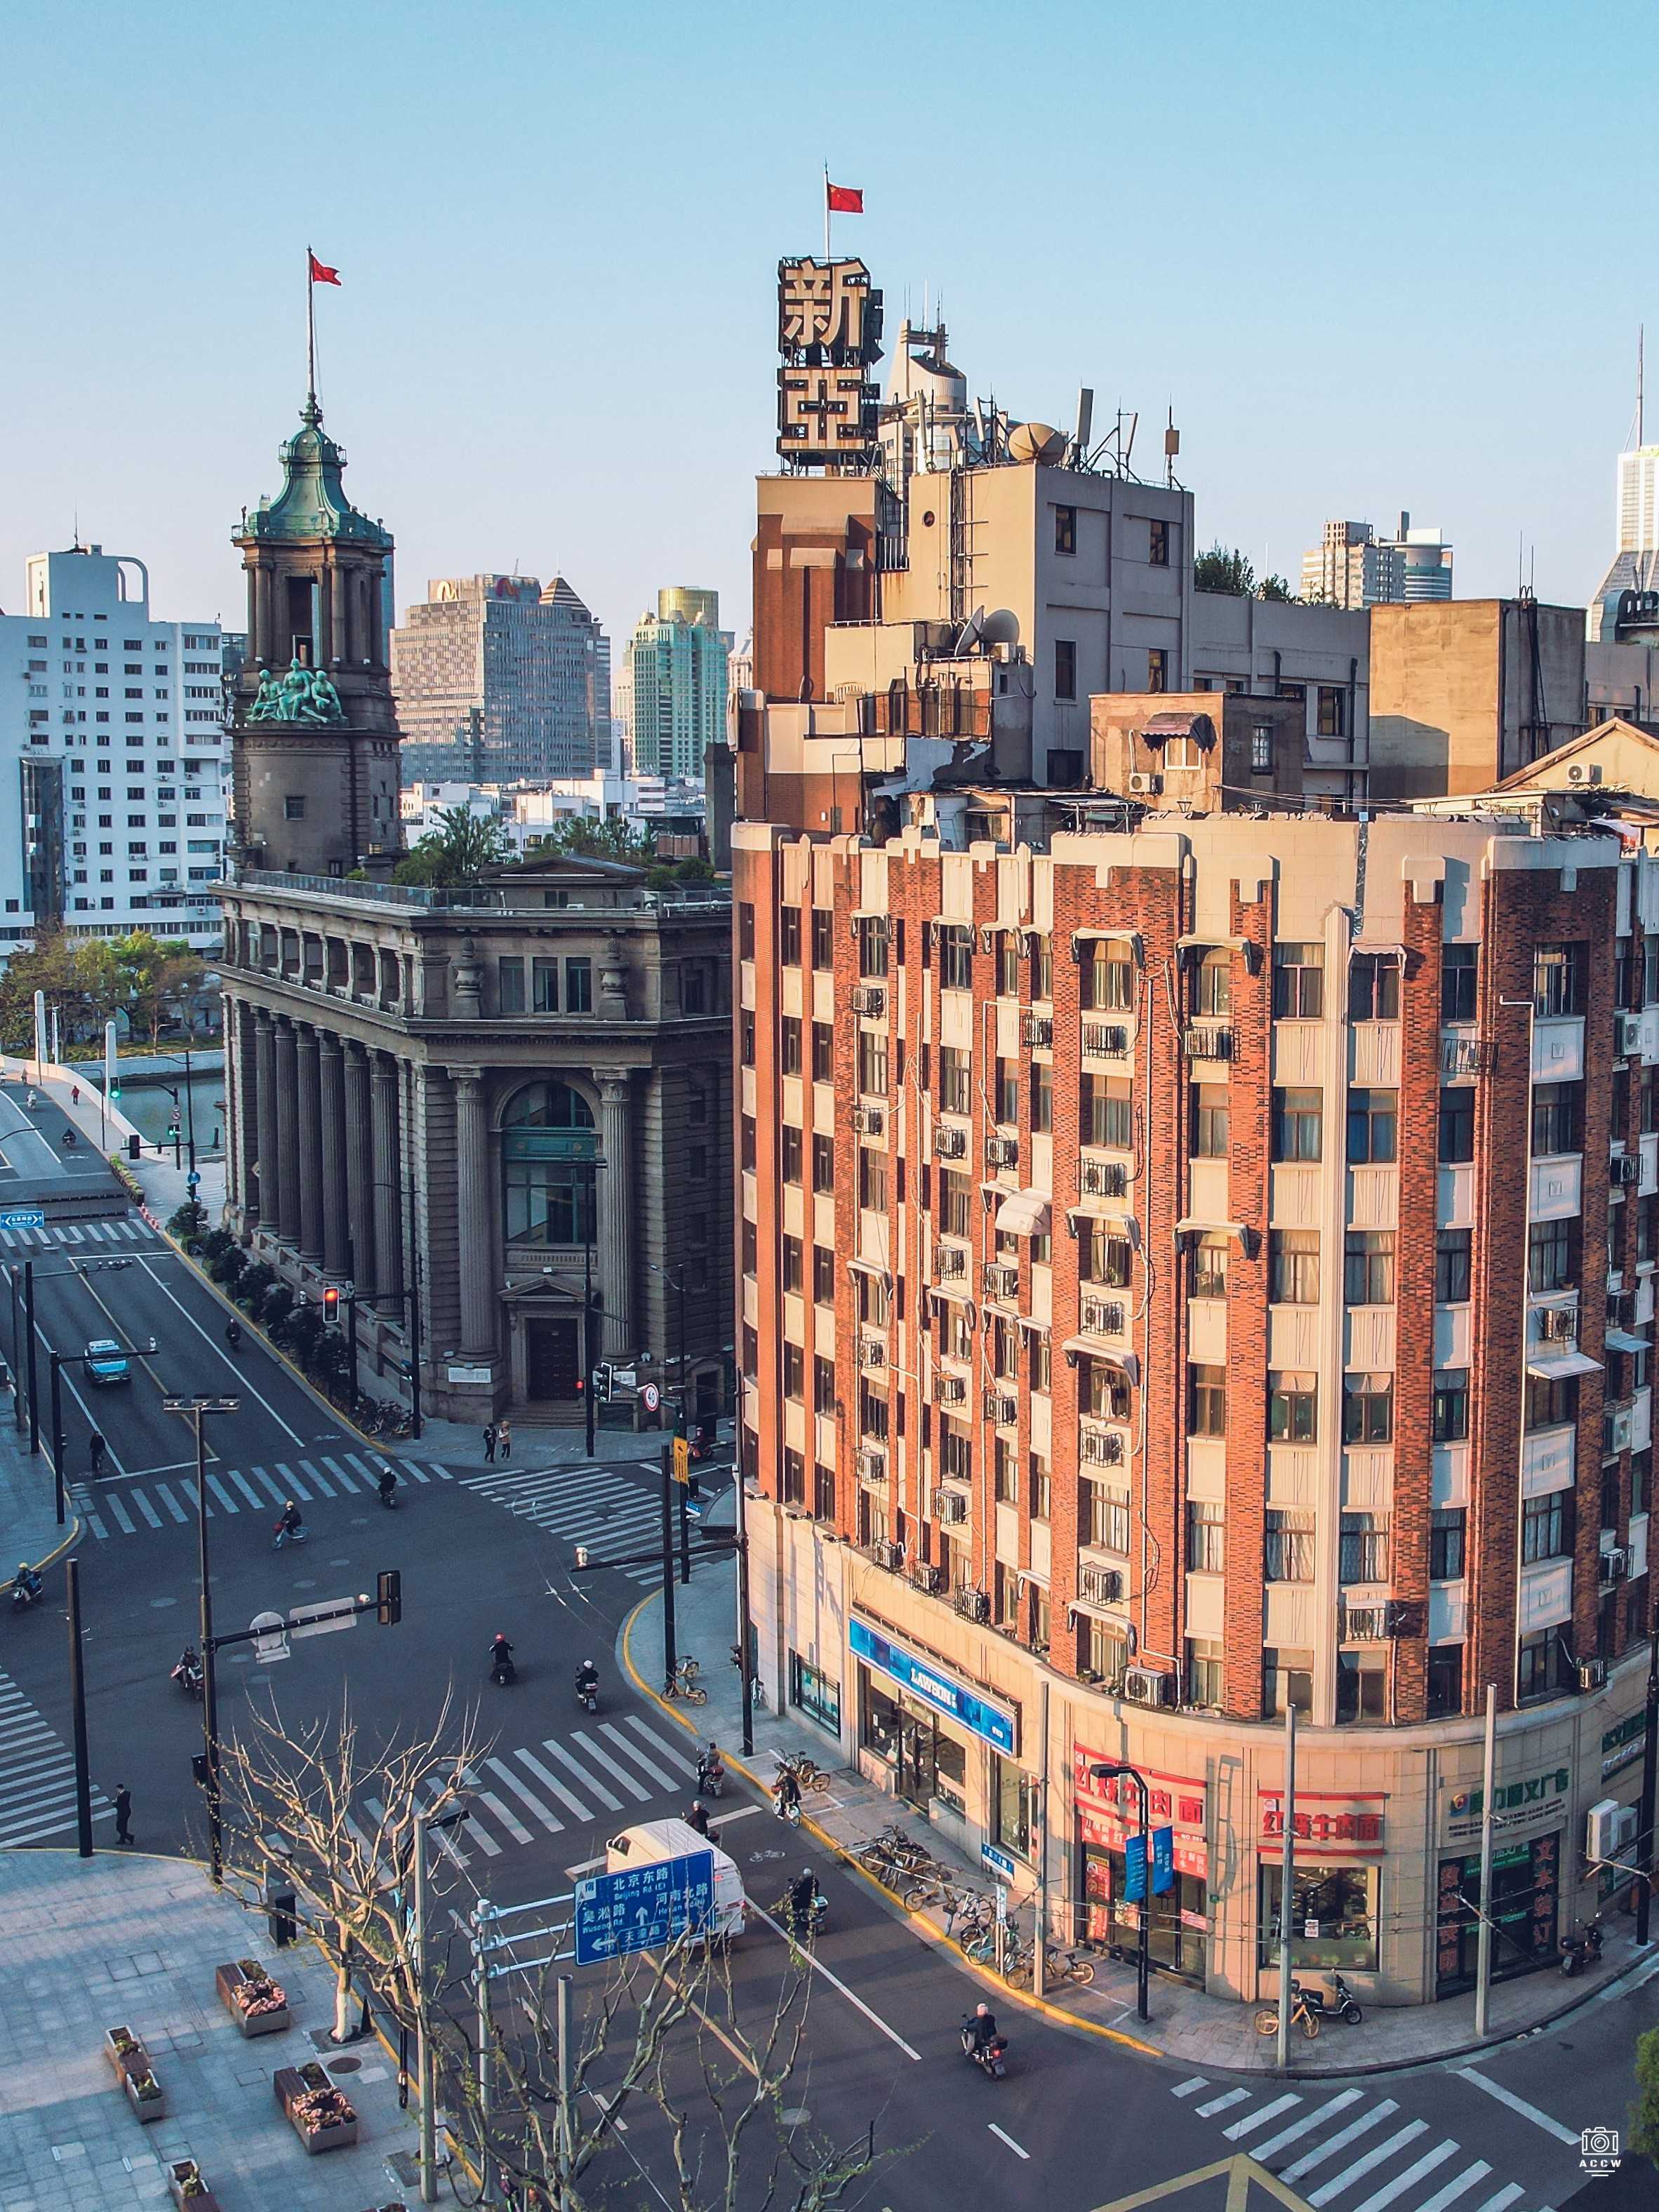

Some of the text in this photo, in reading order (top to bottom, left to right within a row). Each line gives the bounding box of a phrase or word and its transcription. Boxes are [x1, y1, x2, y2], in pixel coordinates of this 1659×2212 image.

[779, 257, 871, 451] 新亞
[910, 1667, 952, 1705] LAWSON
[613, 1867, 668, 1891] 北京东路
[614, 1890, 640, 1901] Beijing
[656, 1882, 708, 1905] 河南北路
[582, 1903, 626, 1925] 吴淞路
